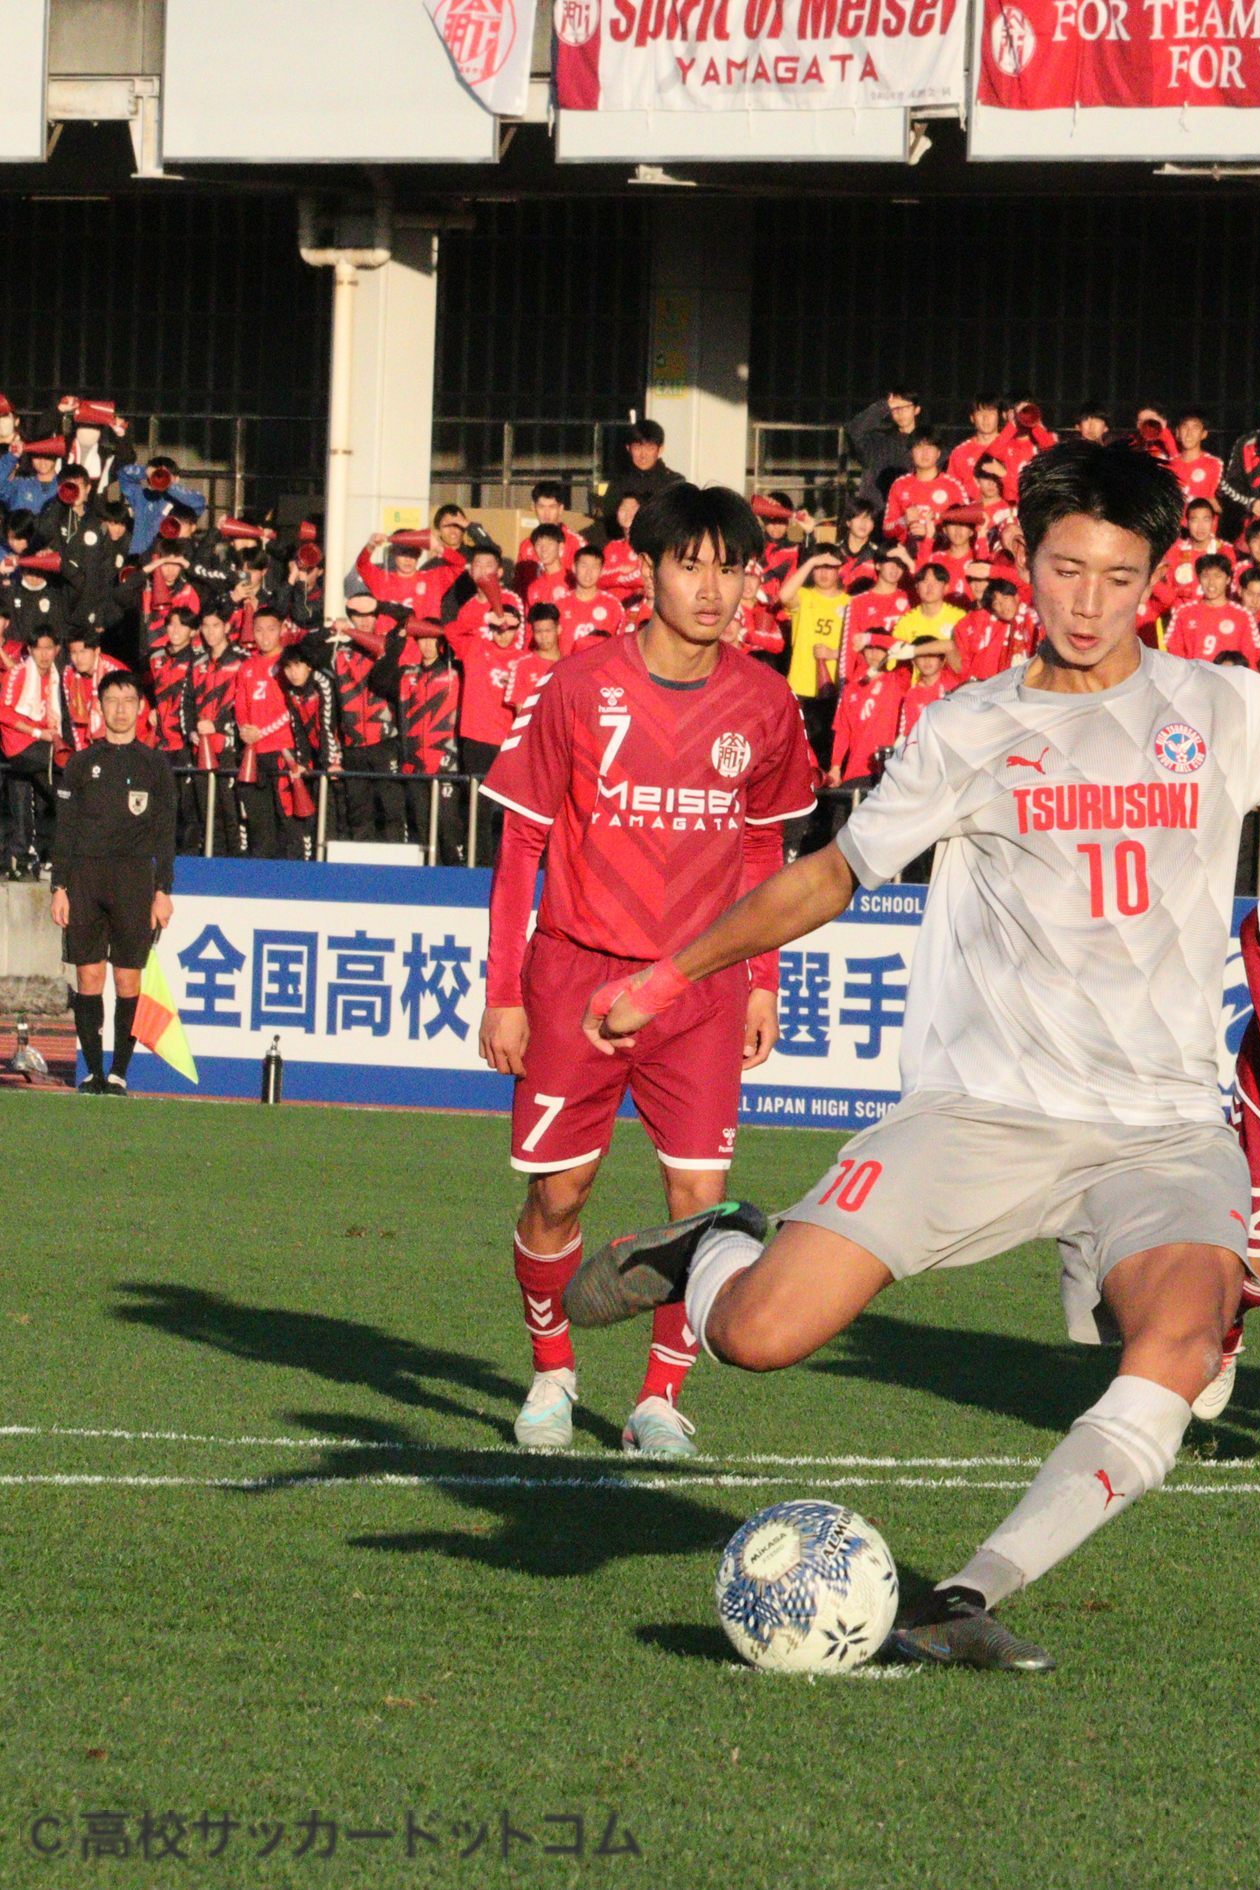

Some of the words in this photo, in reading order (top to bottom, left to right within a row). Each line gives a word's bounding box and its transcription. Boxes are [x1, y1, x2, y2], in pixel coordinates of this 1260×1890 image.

[1052, 0, 1130, 42] FOR
[675, 54, 880, 87] YAMAGATA
[1168, 45, 1246, 89] FOR
[814, 618, 834, 636] 55
[1203, 634, 1217, 655] 9
[599, 714, 631, 777] 7
[591, 812, 739, 832] YAMAGATA
[1013, 782, 1199, 835] TSURUSAKI
[1077, 840, 1149, 918] 10
[860, 895, 924, 914] SCHOOL
[177, 924, 487, 1041] 全国高校
[774, 950, 908, 1060] 選手
[521, 1092, 566, 1153] 7
[756, 1096, 805, 1115] JAPAN
[811, 1099, 848, 1117] HIGH
[817, 1159, 883, 1212] 10
